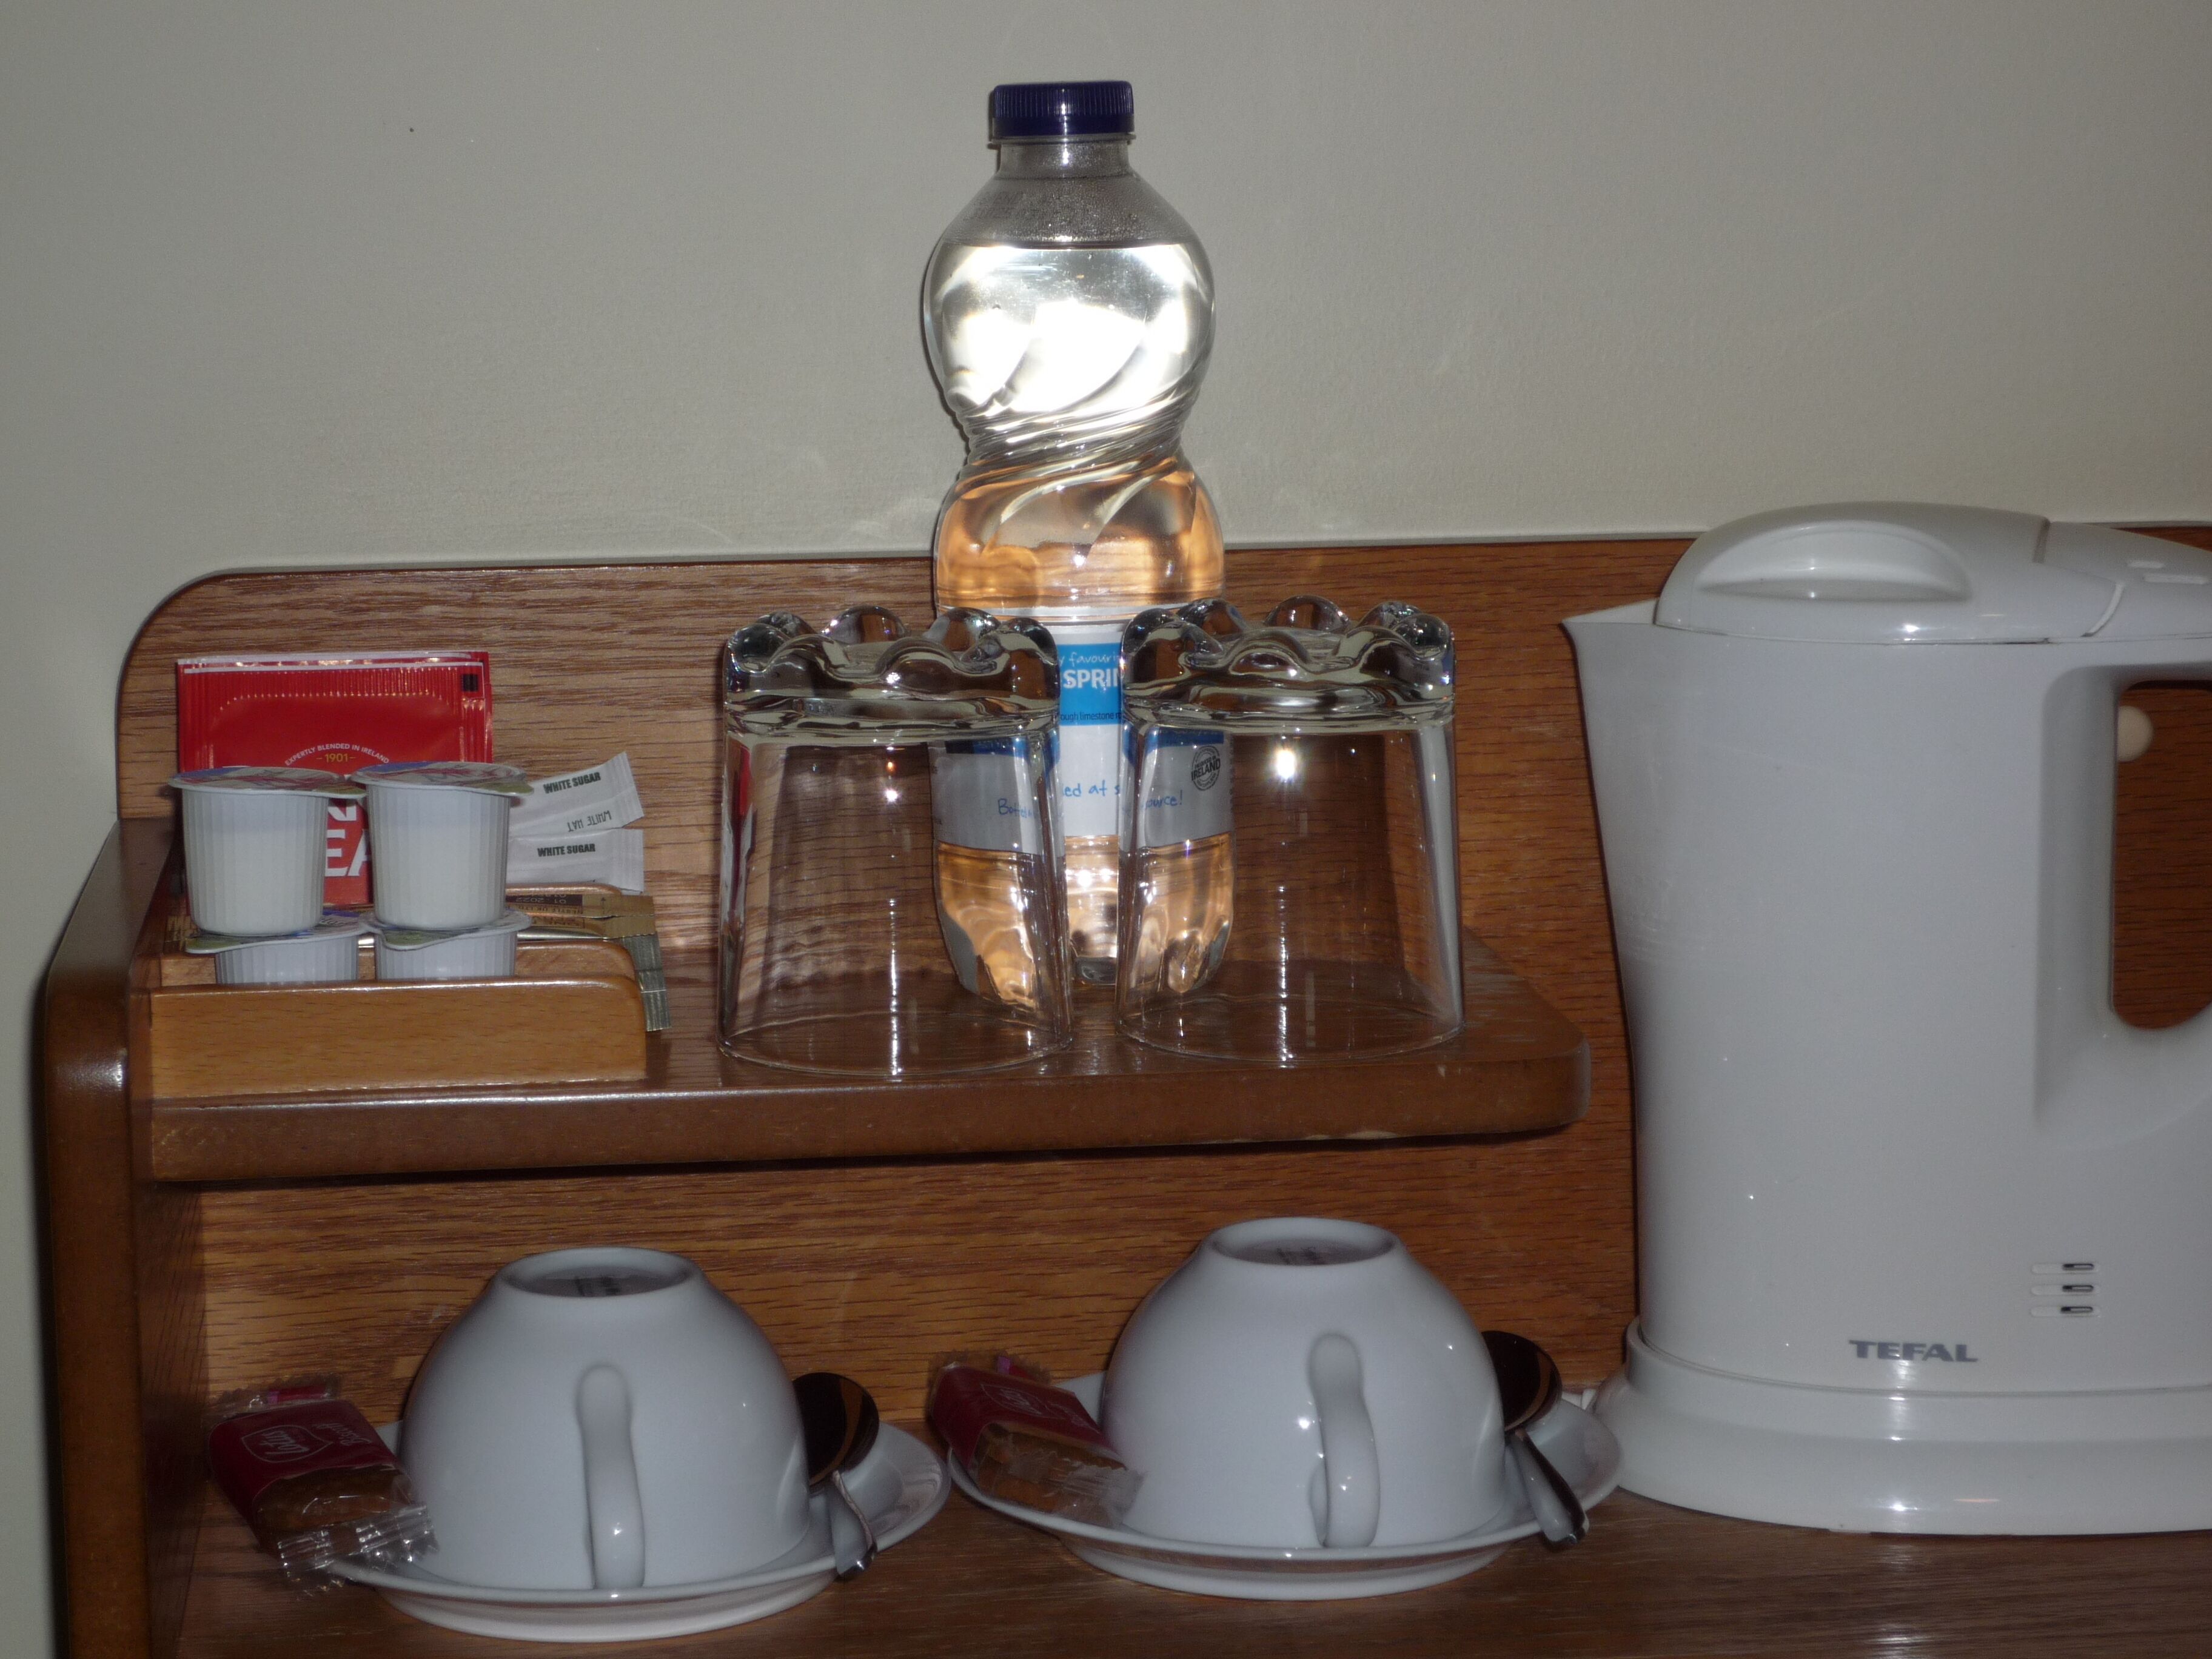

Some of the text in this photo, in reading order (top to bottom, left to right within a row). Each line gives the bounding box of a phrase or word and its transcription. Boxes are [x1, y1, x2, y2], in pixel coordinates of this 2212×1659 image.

[1068, 652, 1119, 667] favouri
[1062, 668, 1119, 689] SPRI
[1061, 711, 1079, 722] ough
[1080, 712, 1114, 720] limestone
[284, 746, 316, 766] EXPERTLY
[317, 743, 350, 752] BLENDED
[361, 746, 390, 764] IRELAND
[324, 753, 349, 763] 1901
[1191, 758, 1221, 781] IRELAND
[543, 771, 601, 794] WHITE SUGAR
[1088, 780, 1107, 796] at
[324, 829, 367, 877] EA
[537, 843, 597, 857] WHITE SUGAR
[1849, 1339, 1979, 1362] TEFAL
